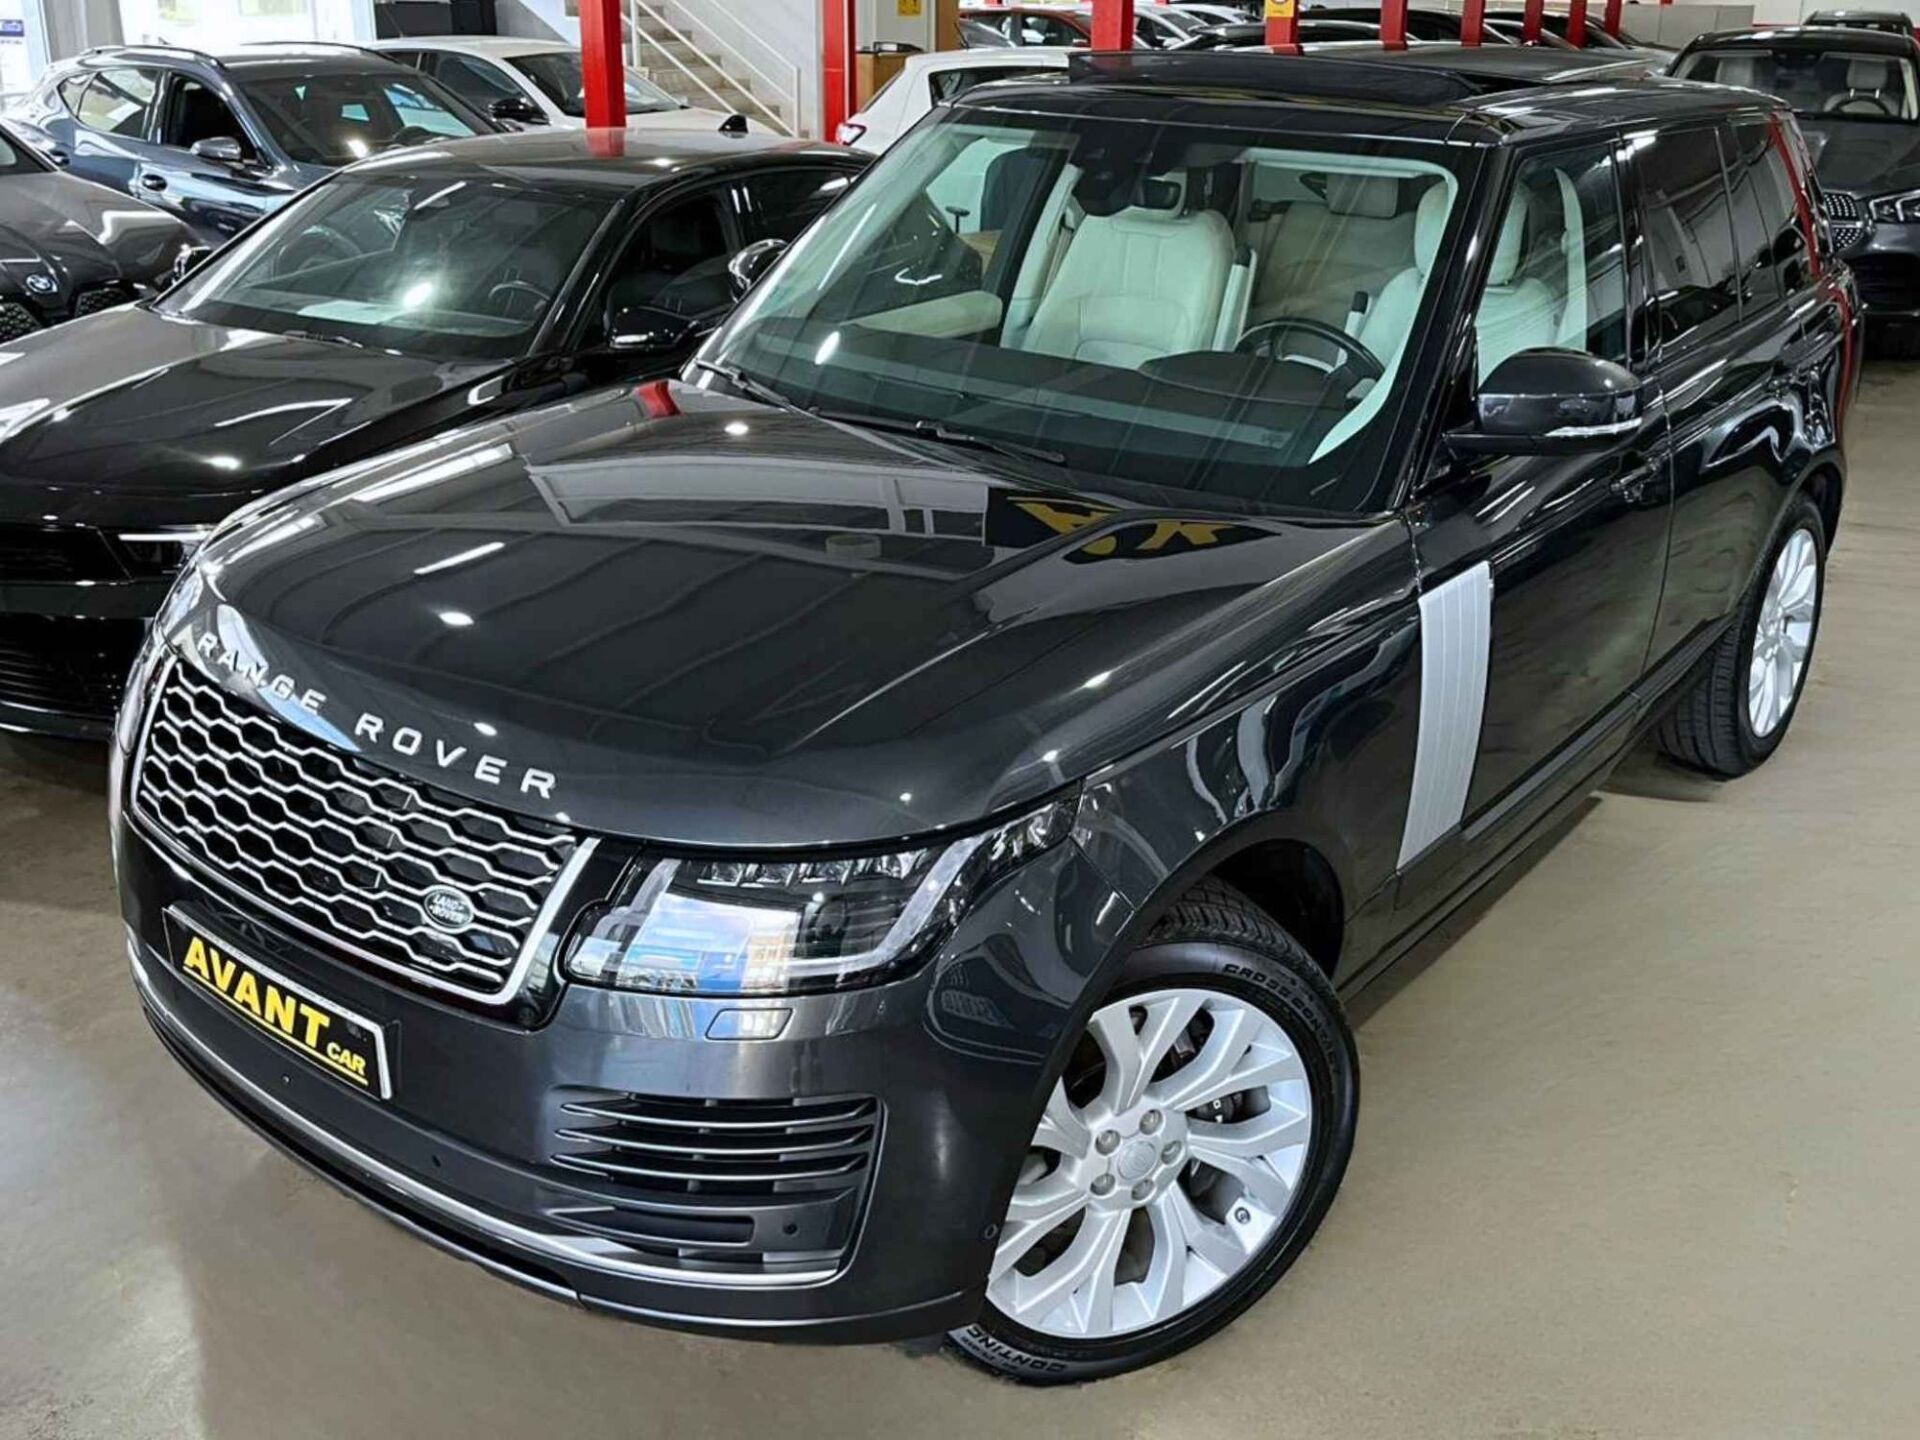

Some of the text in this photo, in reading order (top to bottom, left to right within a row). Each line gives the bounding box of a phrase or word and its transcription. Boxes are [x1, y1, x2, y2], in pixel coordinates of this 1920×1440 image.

[198, 631, 556, 799] RANGE ROVER
[183, 936, 366, 1075] AVANT CAR
